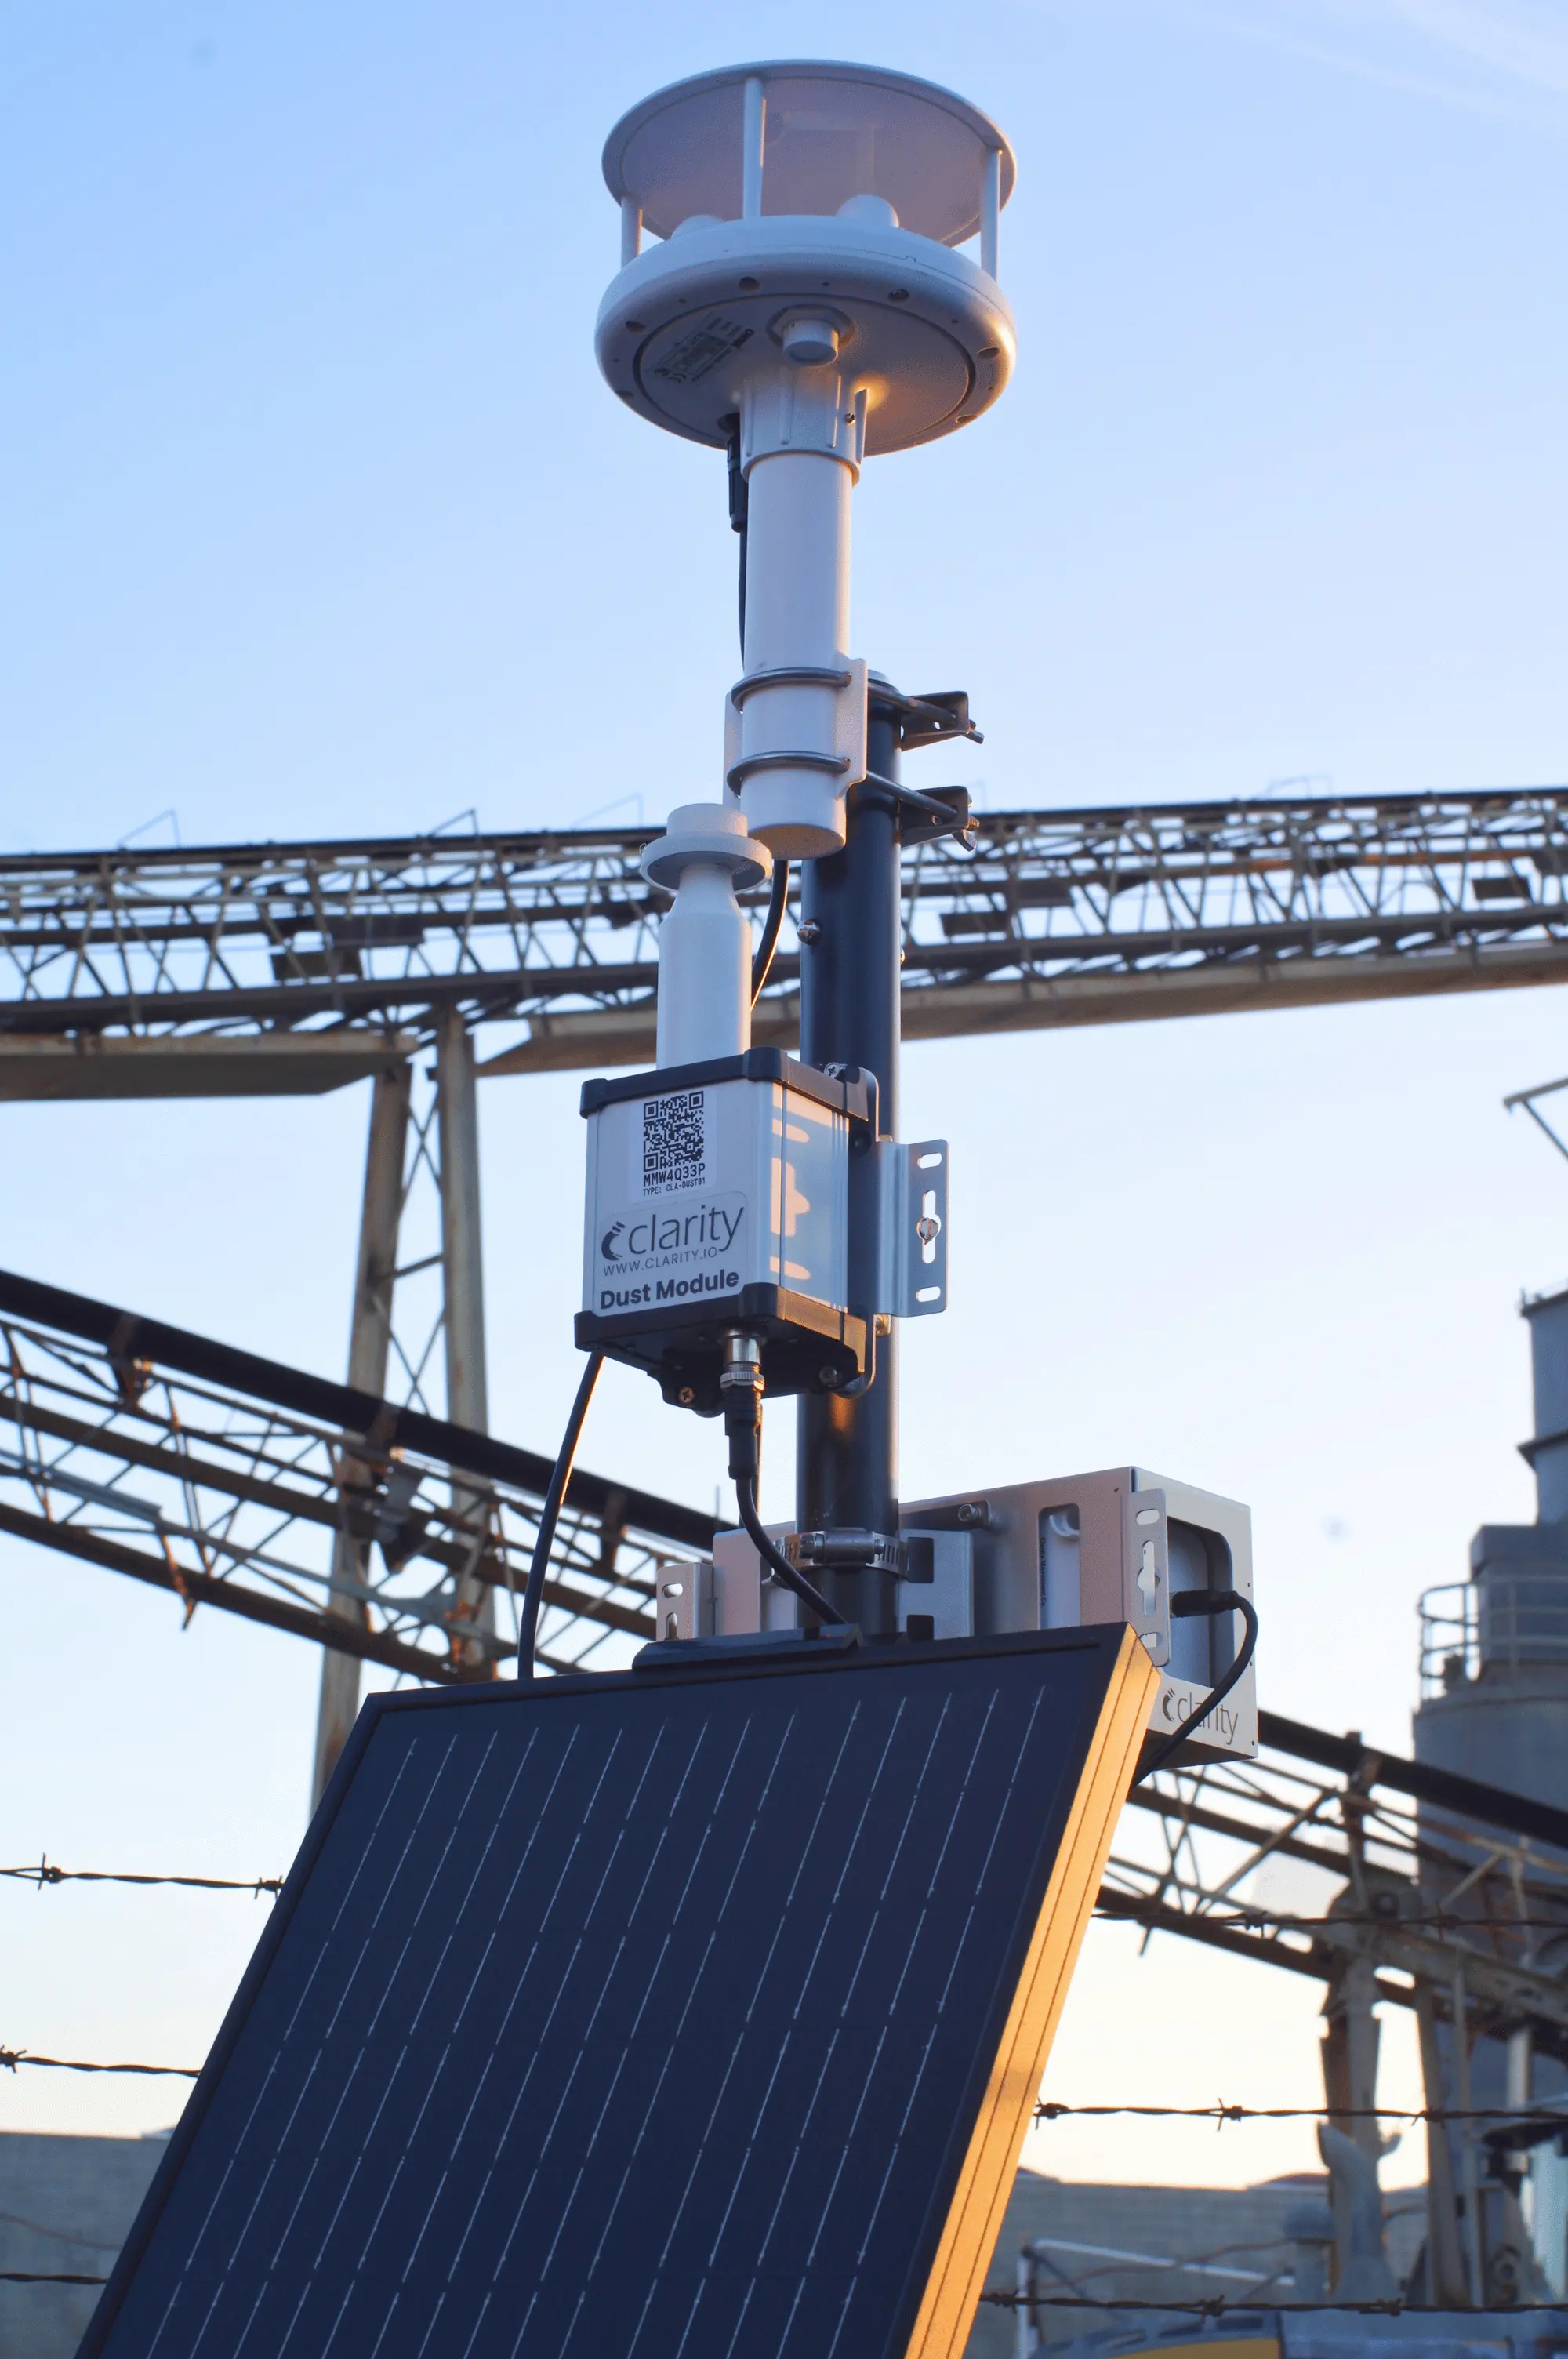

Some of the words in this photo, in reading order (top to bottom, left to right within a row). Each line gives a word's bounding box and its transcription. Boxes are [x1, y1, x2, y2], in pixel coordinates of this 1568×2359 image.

[642, 1186, 662, 1196] TYPE:
[666, 1177, 706, 1192] CLA-DUST01
[643, 1162, 706, 1187] MMW4Q33P
[628, 1205, 745, 1255] clarity
[603, 1246, 718, 1277] WWW.CLARITY.IO
[600, 1283, 652, 1310] Dust
[655, 1268, 739, 1300] Module
